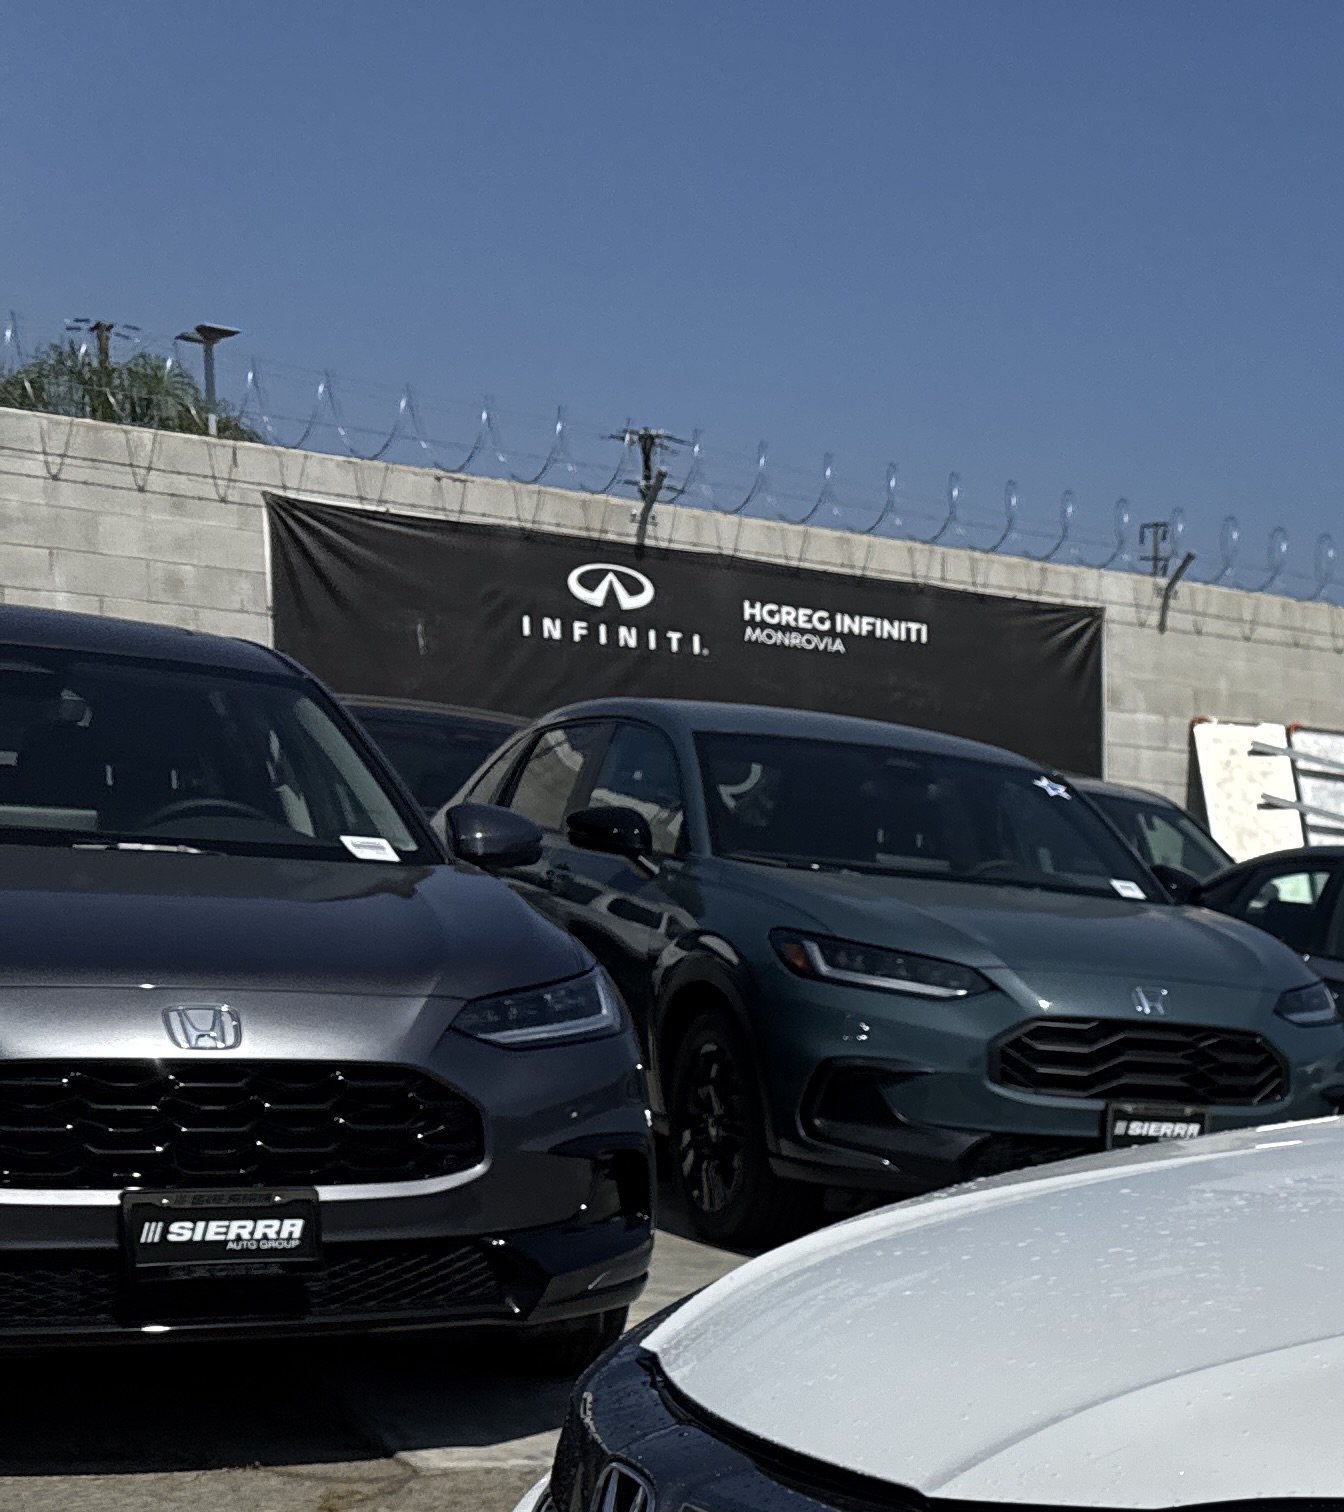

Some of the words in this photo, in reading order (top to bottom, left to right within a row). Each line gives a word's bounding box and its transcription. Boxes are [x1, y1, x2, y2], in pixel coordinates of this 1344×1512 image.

[521, 614, 702, 656] INFINITI
[742, 600, 832, 632] HGREG
[835, 612, 929, 644] INFINITI
[743, 626, 846, 654] MONROVIA
[1127, 1120, 1201, 1138] SIERRA
[166, 1218, 305, 1242] SIERRA
[226, 1240, 257, 1251] AUTO
[259, 1239, 300, 1250] GROUP
